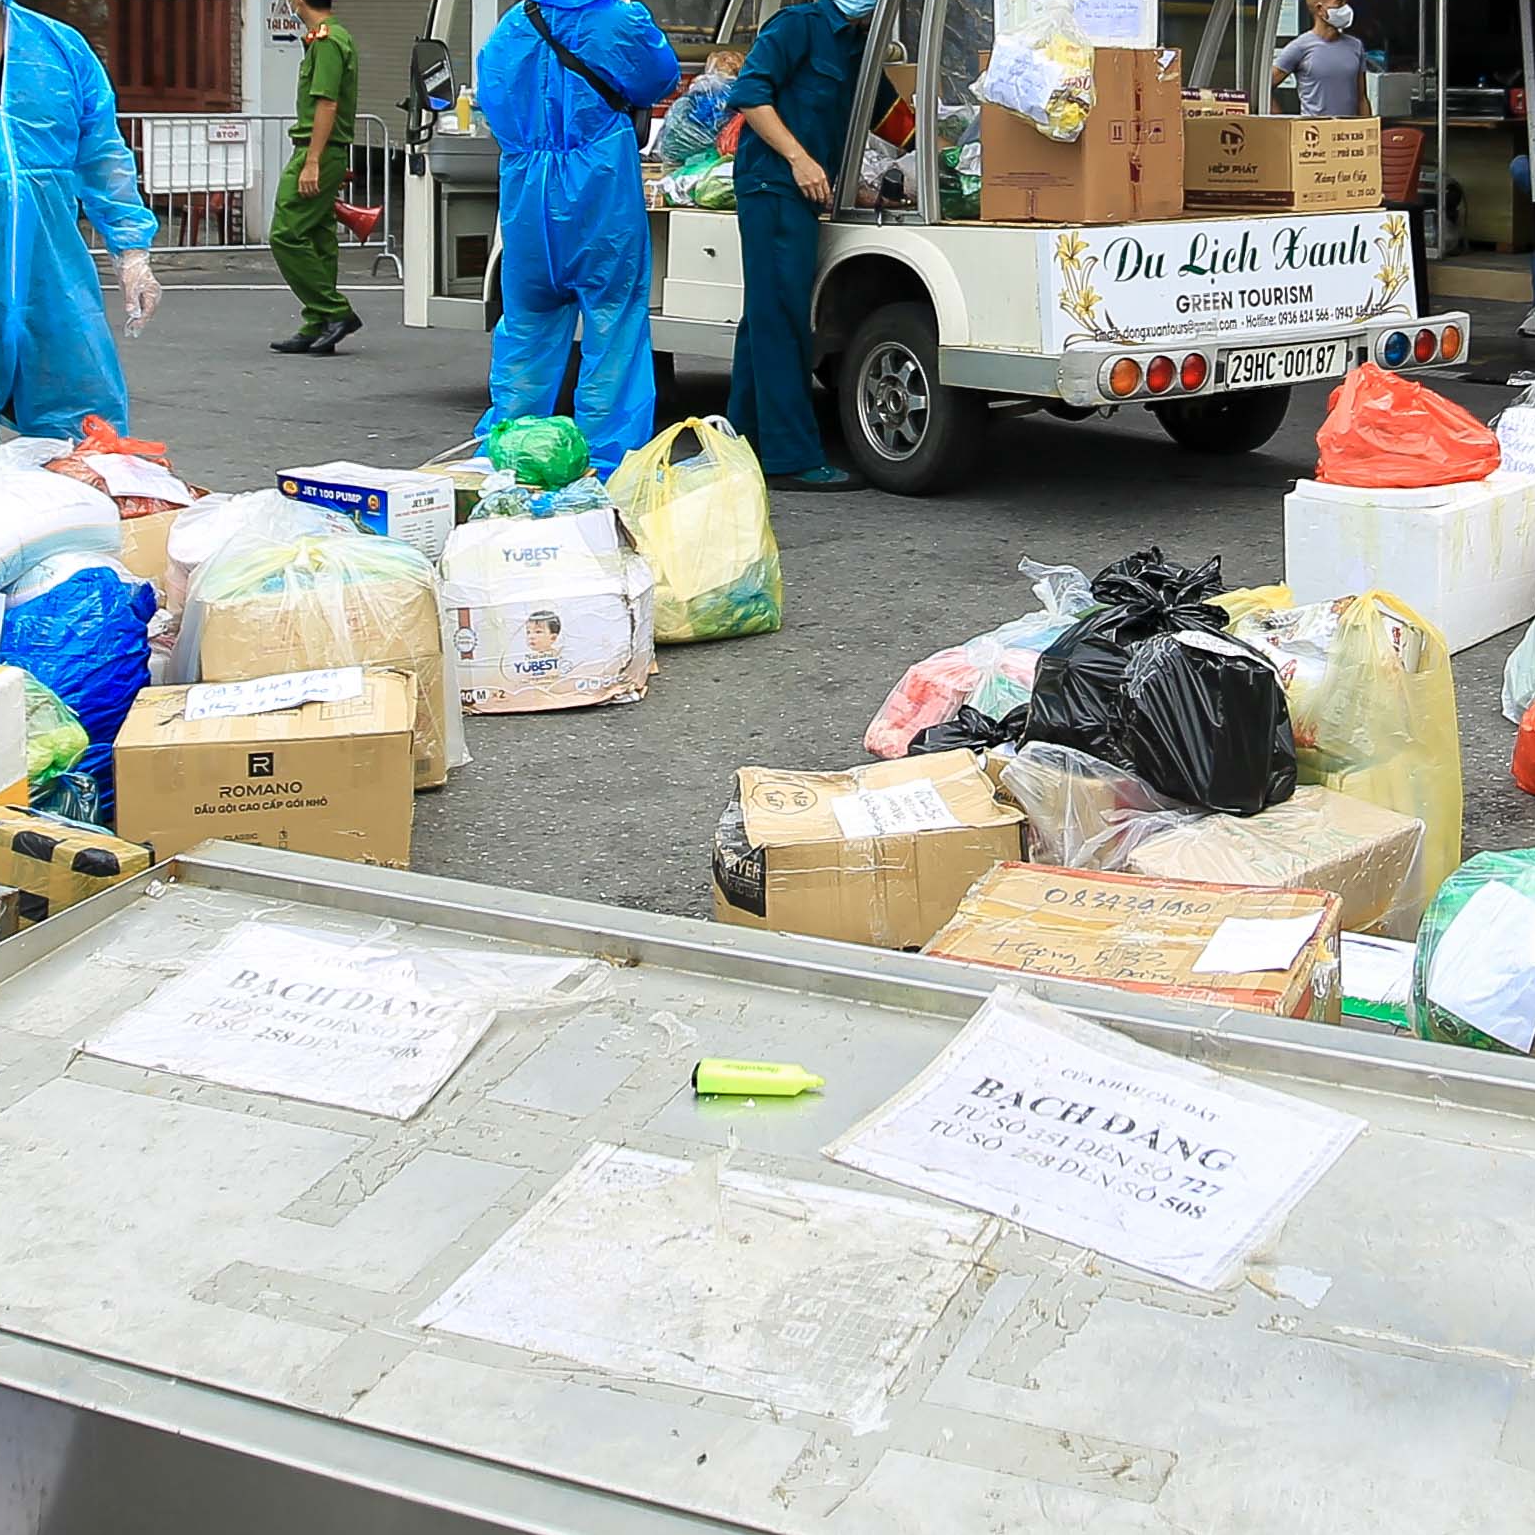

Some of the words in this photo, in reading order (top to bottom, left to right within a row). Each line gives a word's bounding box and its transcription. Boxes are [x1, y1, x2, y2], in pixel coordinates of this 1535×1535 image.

[1104, 237, 1167, 282] Du
[1178, 230, 1261, 284] Lịch
[1272, 224, 1371, 270] Xanh
[1176, 292, 1233, 313] GREEN
[1238, 285, 1313, 309] TOURISM
[1230, 345, 1336, 383] 29HC-001.87
[301, 483, 317, 497] JET
[319, 487, 334, 500] 100
[335, 490, 363, 504] PUMP
[195, 802, 216, 815] DẦU
[218, 801, 237, 815] GỘI
[239, 803, 260, 812] CAO
[263, 799, 283, 811] CẤP
[286, 797, 304, 809] GÓI
[219, 781, 303, 799] ROMANO
[970, 1076, 1096, 1125] BẠCH
[1100, 1111, 1237, 1172] ĐẰNG
[990, 1111, 1027, 1135] SỐ
[1074, 1137, 1131, 1168] ĐẾN
[1135, 1160, 1173, 1183] SỐ
[1177, 1175, 1224, 1199] 727
[967, 1128, 1003, 1152] SỐ
[1118, 1179, 1158, 1203] SỐ
[1158, 1195, 1208, 1221] 508
